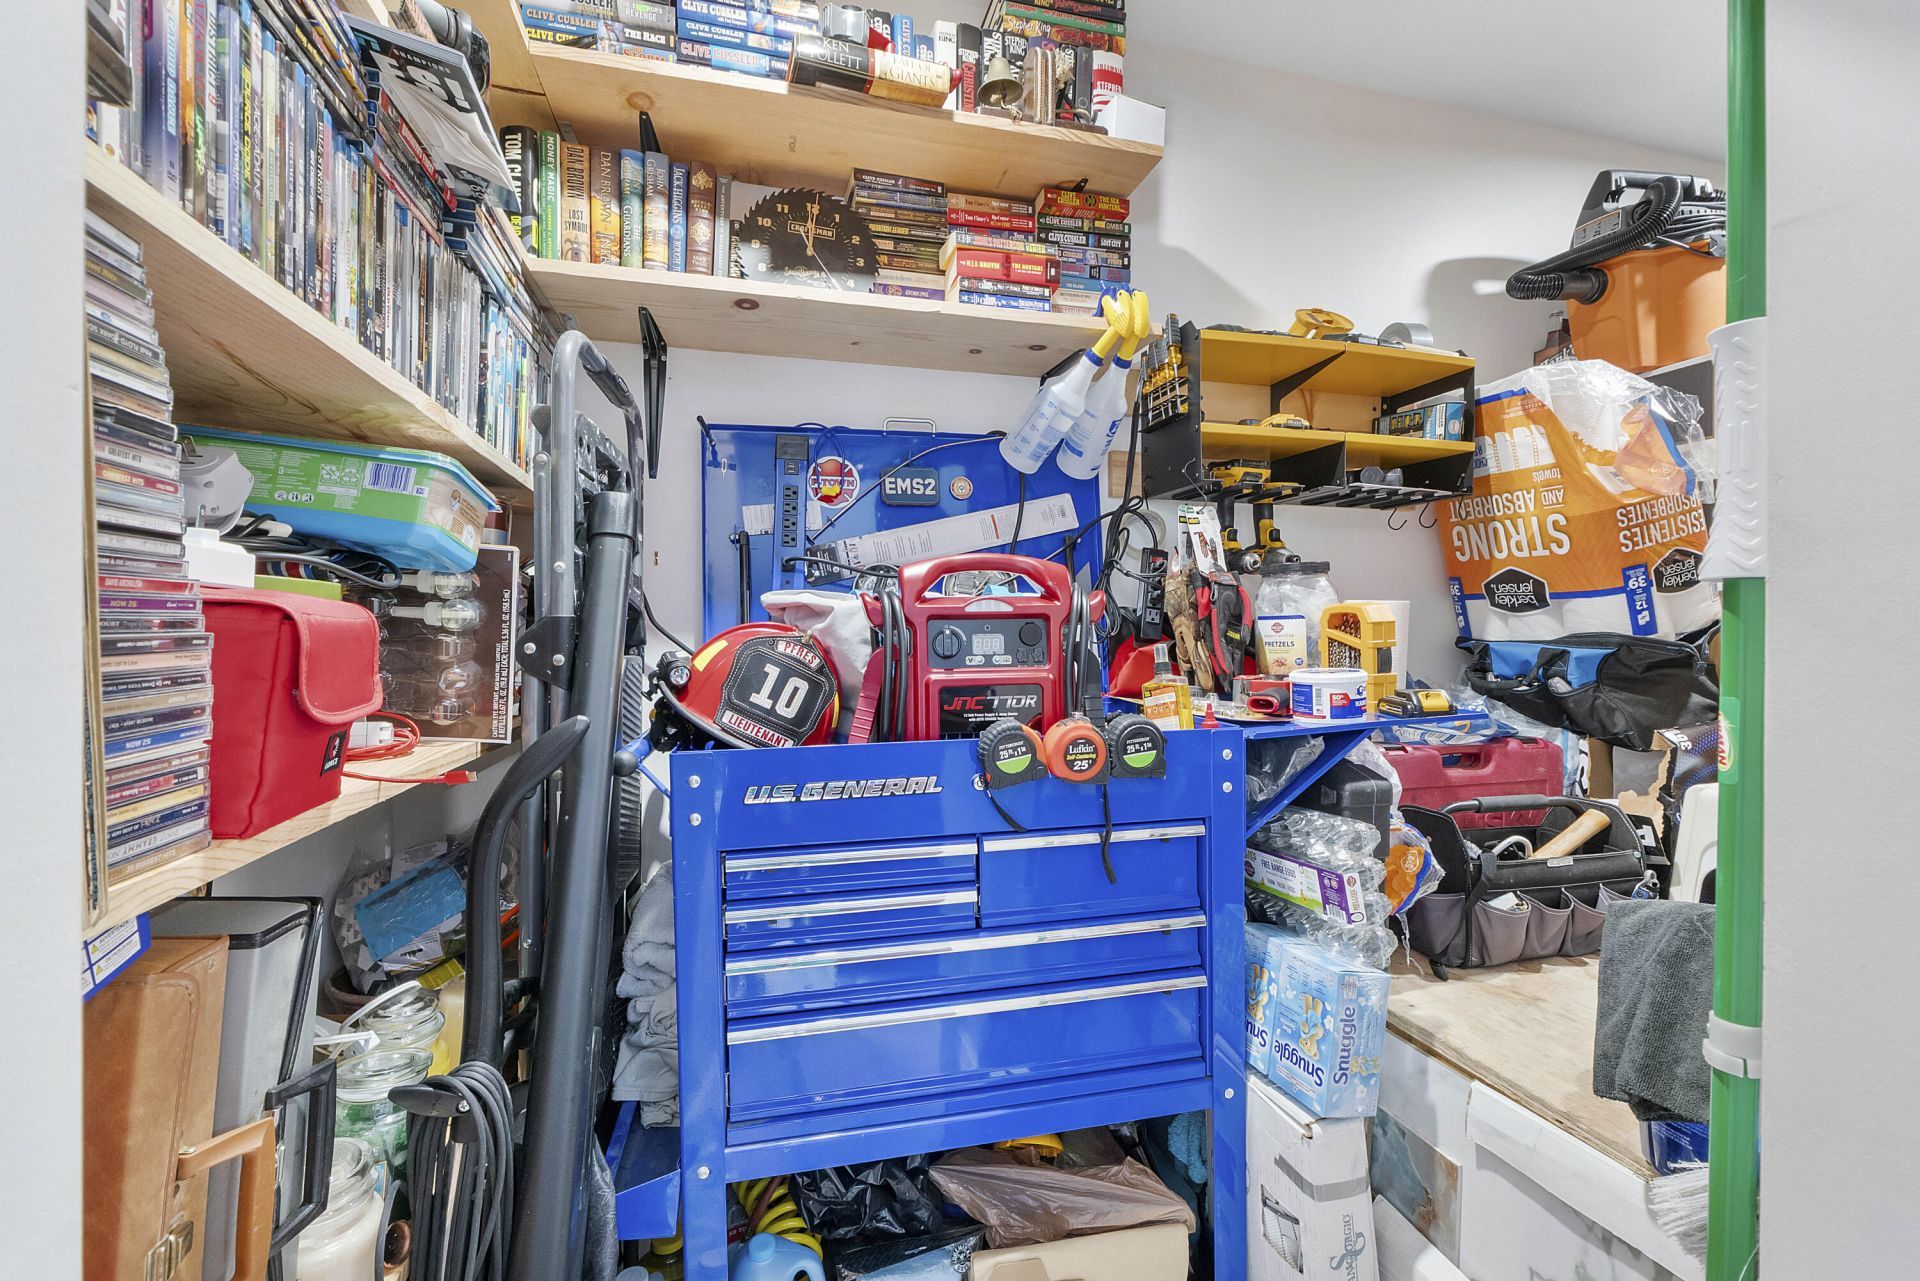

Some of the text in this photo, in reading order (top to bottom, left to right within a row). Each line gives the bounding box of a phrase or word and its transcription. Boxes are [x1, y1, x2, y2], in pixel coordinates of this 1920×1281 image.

[681, 0, 747, 20] CLIVE CUSSLER
[526, 8, 555, 21] CLIVE
[557, 13, 598, 29] CUSSLER
[526, 27, 554, 41] CLIVE
[623, 28, 666, 44] THE RACE
[686, 22, 745, 38] CLIVE CUSSLER
[1007, 17, 1051, 39] Stephen King
[823, 38, 849, 52] KEN
[938, 35, 956, 43] KING
[680, 42, 758, 66] CLIVE CUSSLER
[1009, 45, 1025, 56] KING
[208, 12, 217, 107] DISTRICT 9
[392, 48, 451, 74] CHAMPIONS
[890, 64, 935, 88] GIANTS
[241, 66, 252, 182] SOURCE CODE
[252, 107, 262, 201] AGE ADALINE
[504, 132, 522, 160] TOM
[546, 136, 556, 202] MONEY MAGIC
[566, 146, 585, 200] DAN BROWN
[673, 166, 686, 188] JACK
[646, 159, 656, 196] GRISHAM
[656, 168, 665, 190] JOHN
[600, 151, 612, 225] DAN BROWN
[1061, 190, 1077, 198] CLIVE
[672, 188, 683, 224] HIGGINS
[1057, 197, 1080, 206] CUSSLER
[1099, 195, 1109, 203] THE
[568, 209, 584, 221] LOST
[776, 203, 789, 214] 11
[806, 202, 820, 214] 12
[756, 216, 772, 227] 10
[833, 213, 840, 223] 1
[1045, 216, 1082, 227] CLIVE CUSSLER
[1105, 221, 1124, 231] OMBS
[564, 220, 588, 234] SYMBOL
[623, 205, 633, 257] GUARDIANS
[790, 223, 834, 238] CRAFSMAN
[751, 239, 761, 249] 9
[851, 235, 861, 245] 2
[1048, 232, 1087, 244] CLIVE CUSSLER
[757, 262, 767, 272] 8
[856, 258, 865, 267] 3
[846, 279, 856, 289] 4
[108, 447, 142, 463] GREATEST HITS
[1532, 467, 1560, 482] towels
[885, 477, 937, 495] EMS2
[1449, 488, 1564, 522] AND ABSORBENT
[1452, 512, 1571, 561] STRONG
[1618, 508, 1705, 553] ESISTENTES
[1662, 568, 1698, 588] berkley
[1494, 593, 1539, 607] berkley
[1635, 600, 1649, 610] 12
[501, 628, 509, 639] 5.36
[501, 640, 509, 653] TOTAL
[1264, 640, 1295, 648] PRETZELS
[783, 641, 817, 665] PFRES
[749, 663, 809, 719] 10
[728, 713, 789, 748] LIEUTENANT
[125, 740, 141, 749] NOW
[1068, 744, 1095, 754] Lufkin
[1066, 752, 1097, 761] Self-Centering
[1072, 760, 1092, 770] 25'
[800, 775, 944, 802] GENERAL
[1261, 858, 1297, 879] FREE RANGE EGGS
[1333, 1006, 1357, 1086] Snuggle
[1273, 1038, 1325, 1088] Snuggle
